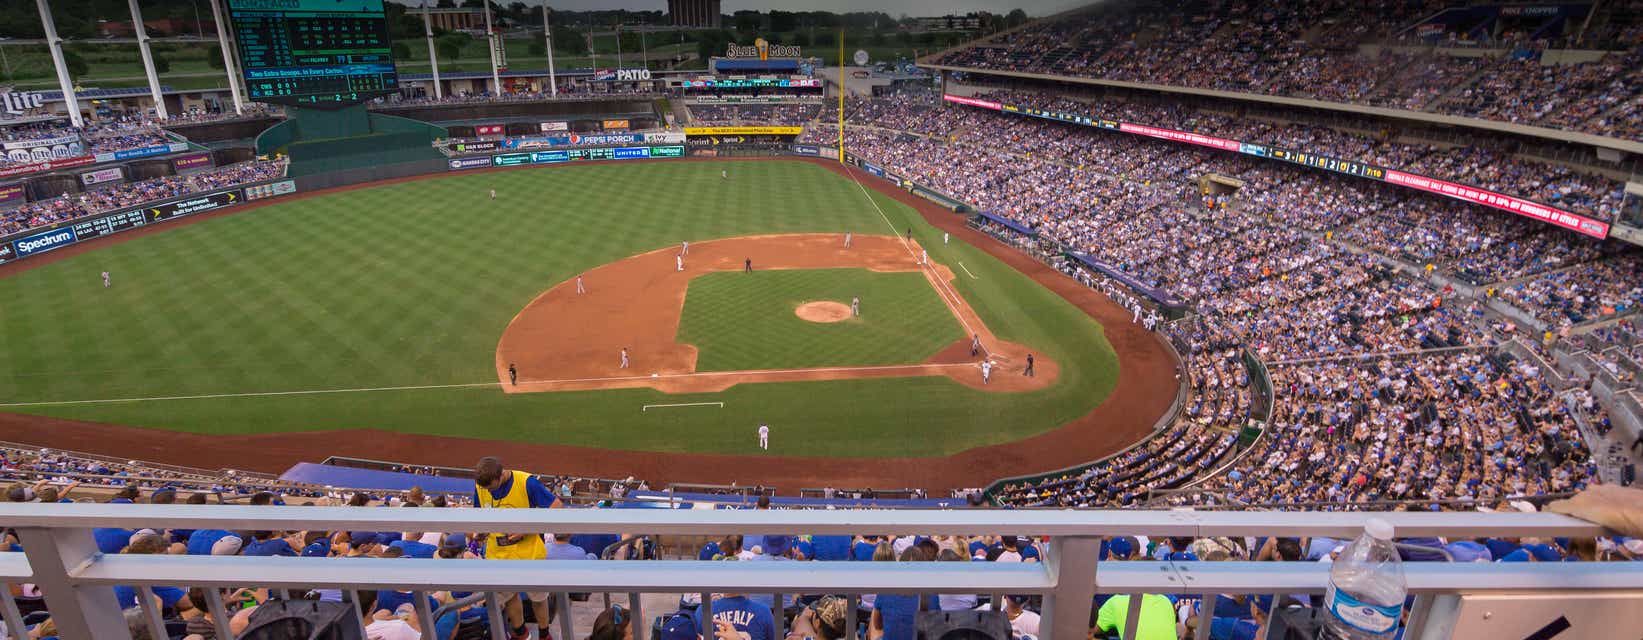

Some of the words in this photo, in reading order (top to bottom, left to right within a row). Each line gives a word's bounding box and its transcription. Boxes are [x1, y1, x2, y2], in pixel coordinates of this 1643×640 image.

[769, 45, 801, 57] MOON
[617, 69, 650, 80] PATIO
[2, 92, 44, 115] Lite
[585, 136, 606, 144] PEPSI
[1330, 160, 1336, 169] 2
[1351, 164, 1357, 173] 2
[188, 198, 209, 207] Network
[193, 202, 218, 211] Unlimited
[1404, 176, 1430, 187] CLEARANCE
[1430, 181, 1442, 190] SALE
[1479, 192, 1488, 200] UP
[1488, 195, 1496, 203] TO
[1520, 203, 1551, 218] HUNDREDS
[1551, 212, 1559, 220] OF
[1559, 214, 1579, 227] STYLES
[18, 231, 71, 253] Spectrum
[713, 610, 755, 626] SHEALY
